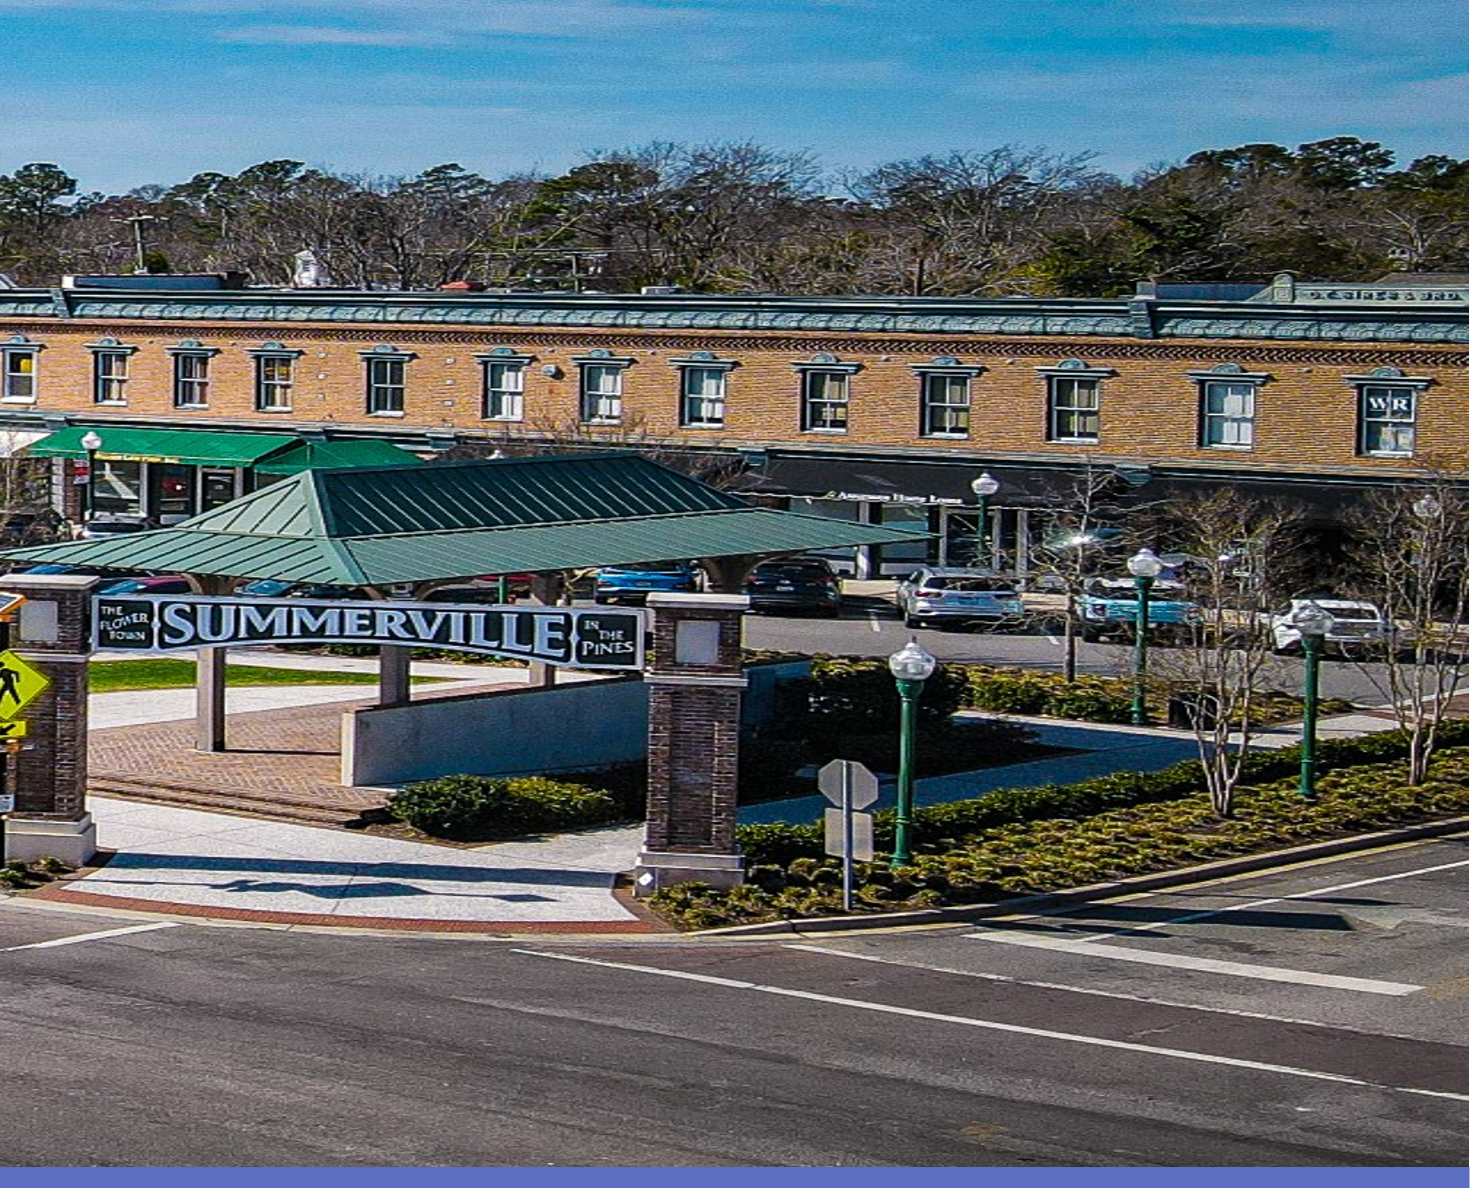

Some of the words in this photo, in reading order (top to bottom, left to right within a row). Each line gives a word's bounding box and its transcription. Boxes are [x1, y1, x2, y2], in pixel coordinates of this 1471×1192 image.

[1369, 397, 1410, 410] WR
[100, 606, 124, 616] THE
[99, 612, 150, 631] FLOWER
[584, 620, 600, 630] IN
[109, 630, 146, 641] TOWN
[163, 603, 566, 656] SUMMERVILLE
[598, 629, 625, 641] THE
[581, 641, 635, 656] PINES
